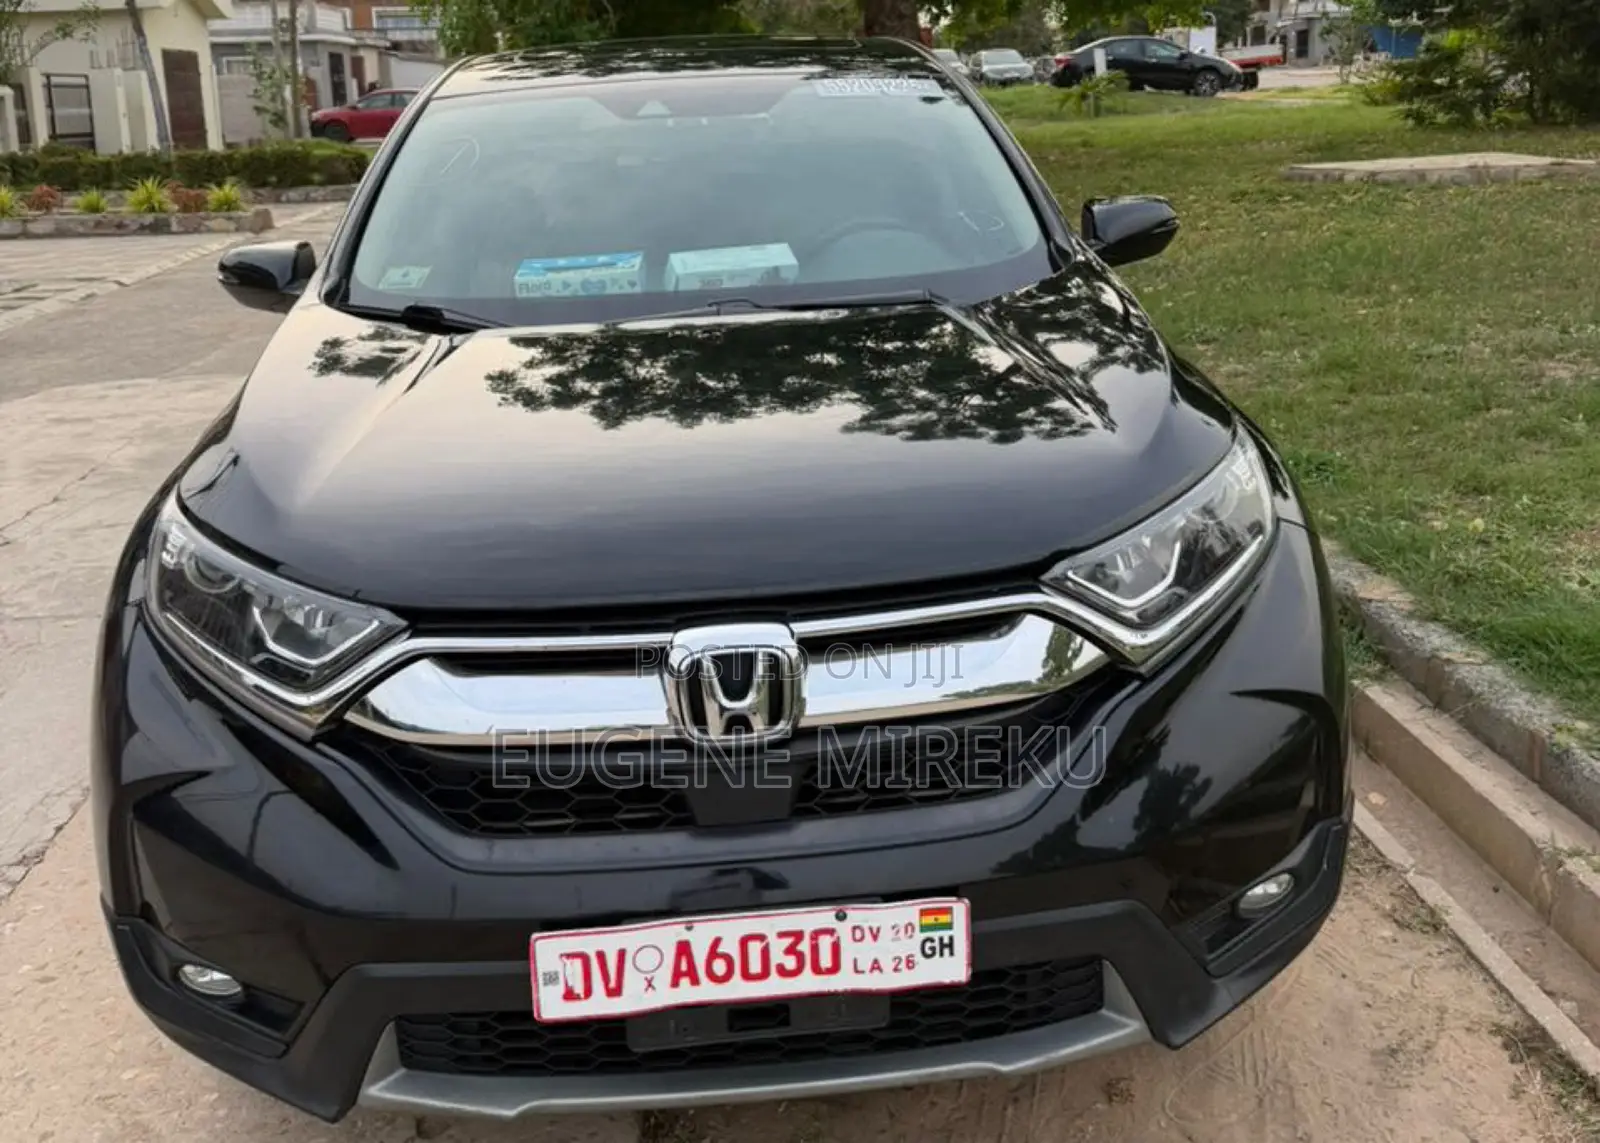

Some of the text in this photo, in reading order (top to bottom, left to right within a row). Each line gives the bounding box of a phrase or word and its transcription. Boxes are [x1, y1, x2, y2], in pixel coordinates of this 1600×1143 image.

[851, 921, 916, 943] DV 20
[919, 934, 956, 960] GH
[560, 927, 842, 1003] DV A6030
[853, 953, 916, 975] LA 26
